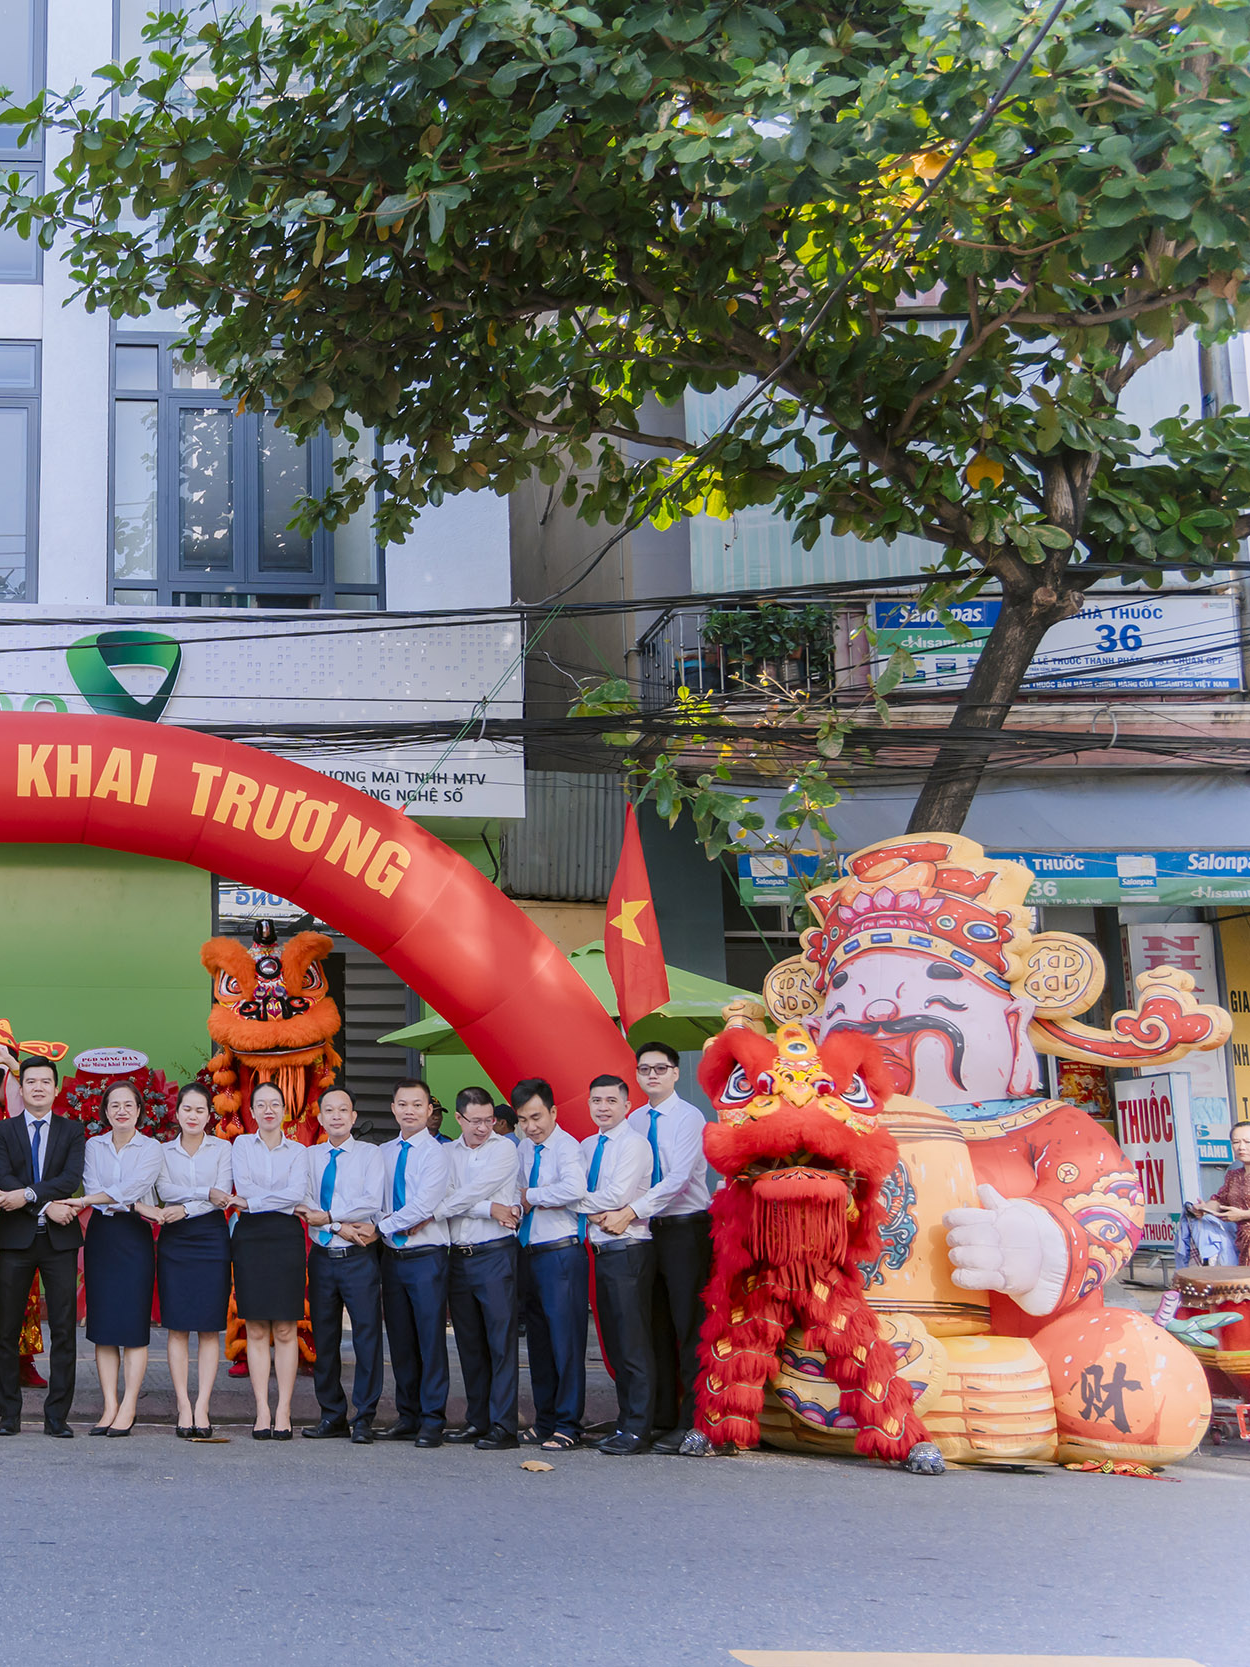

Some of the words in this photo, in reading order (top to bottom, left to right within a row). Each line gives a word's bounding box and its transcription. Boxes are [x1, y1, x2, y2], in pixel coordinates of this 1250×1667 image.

[899, 606, 983, 623] Salopas
[1111, 604, 1163, 619] THUỐC
[1095, 624, 1142, 652] 36
[371, 771, 400, 786] MẠI
[404, 771, 447, 785] TNHH
[453, 773, 486, 786] MTV
[360, 786, 391, 801] ÔNG
[396, 786, 438, 804] NGHỆ
[444, 786, 463, 803] SỐ
[17, 744, 157, 806] KHAI
[191, 762, 412, 899] TRƯƠNG
[1032, 854, 1085, 871] THUỐC
[1187, 853, 1250, 872] Salonp
[1029, 880, 1058, 897] 36
[1121, 877, 1154, 887] Salonpas
[1118, 1082, 1173, 1144] THUỐC
[1135, 1151, 1166, 1205] TÂY
[1079, 1362, 1144, 1434] 财
